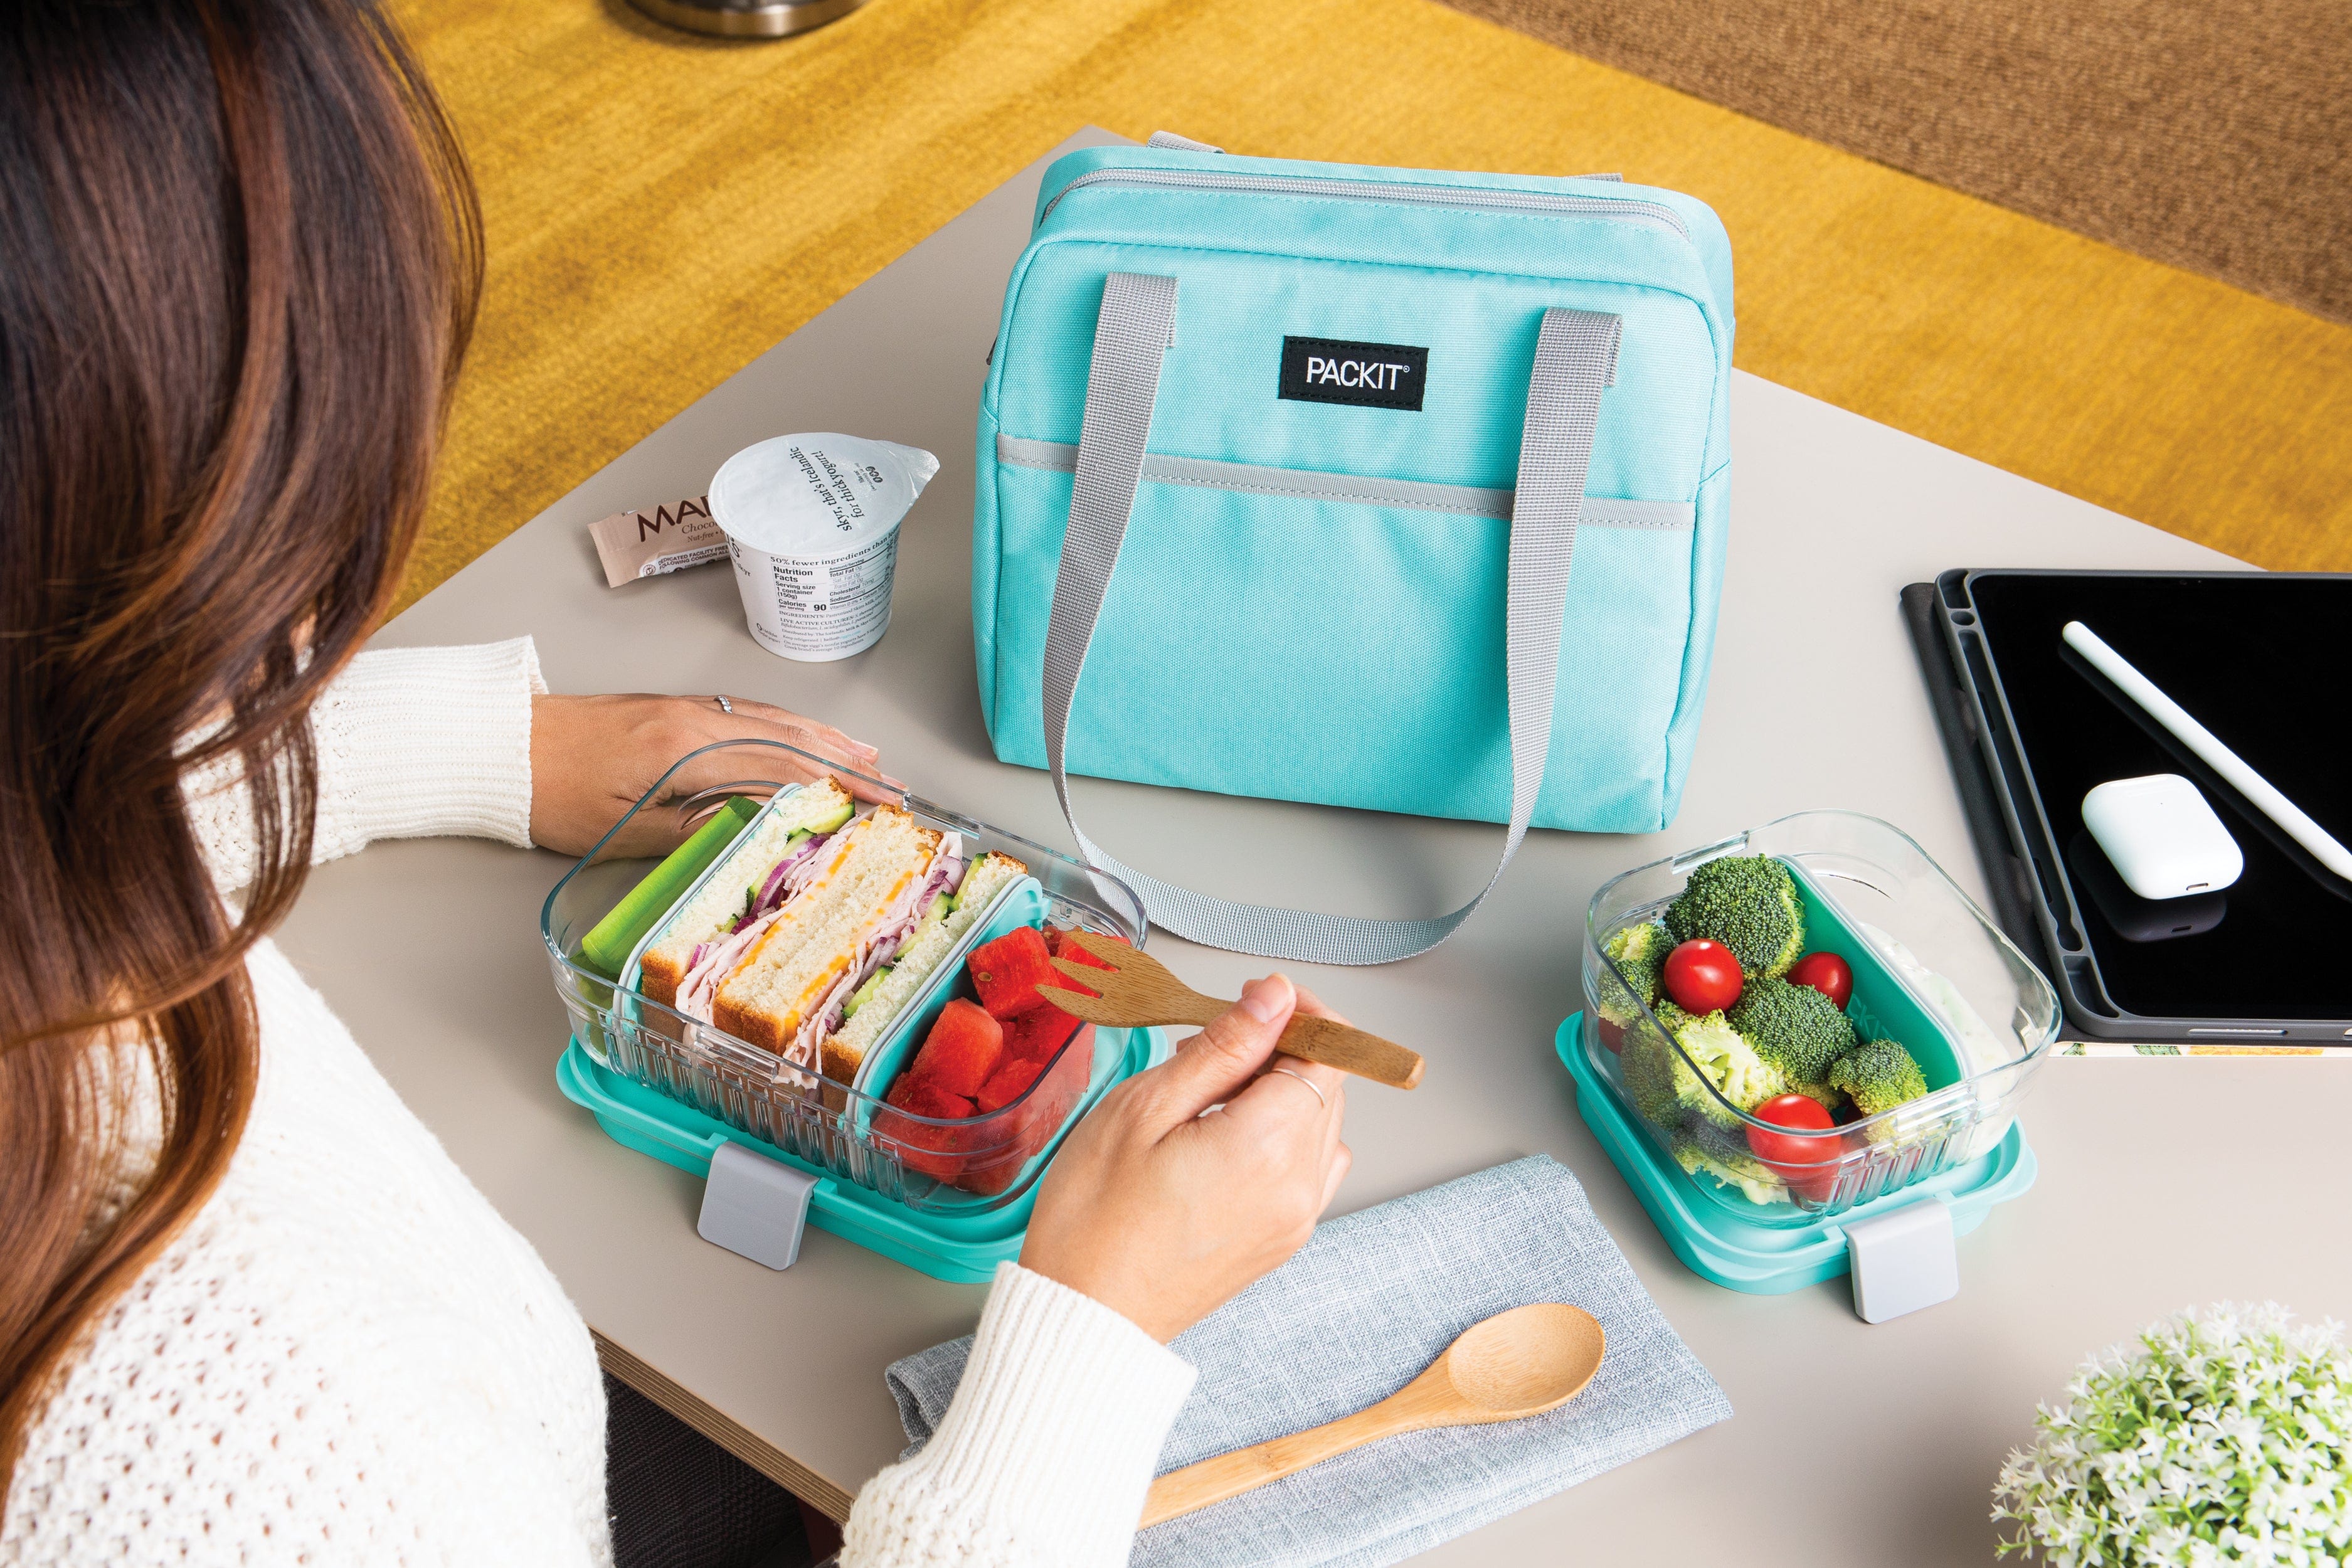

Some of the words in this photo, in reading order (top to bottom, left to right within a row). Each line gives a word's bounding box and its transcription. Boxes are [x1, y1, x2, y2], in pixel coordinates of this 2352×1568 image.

[790, 447, 821, 484] Icelandic
[810, 450, 844, 480] yogurt!
[814, 483, 837, 506] that's
[832, 479, 855, 502] thick
[850, 503, 865, 518] for
[833, 507, 852, 531] skyr,
[687, 532, 714, 543] Nut-free
[658, 554, 688, 566] DEDICATED
[689, 548, 714, 558] FACILITY
[770, 556, 790, 565] 50%
[822, 547, 871, 565] ingredients
[872, 537, 887, 549] than
[659, 558, 689, 570] FOLLOWING
[691, 552, 718, 561] COMMON
[773, 566, 813, 576] Nutrition
[775, 573, 798, 583] Facts
[776, 581, 800, 590] Serving
[829, 585, 861, 596] Cholesterol
[778, 598, 807, 608] Calories
[830, 595, 851, 603] Sodium
